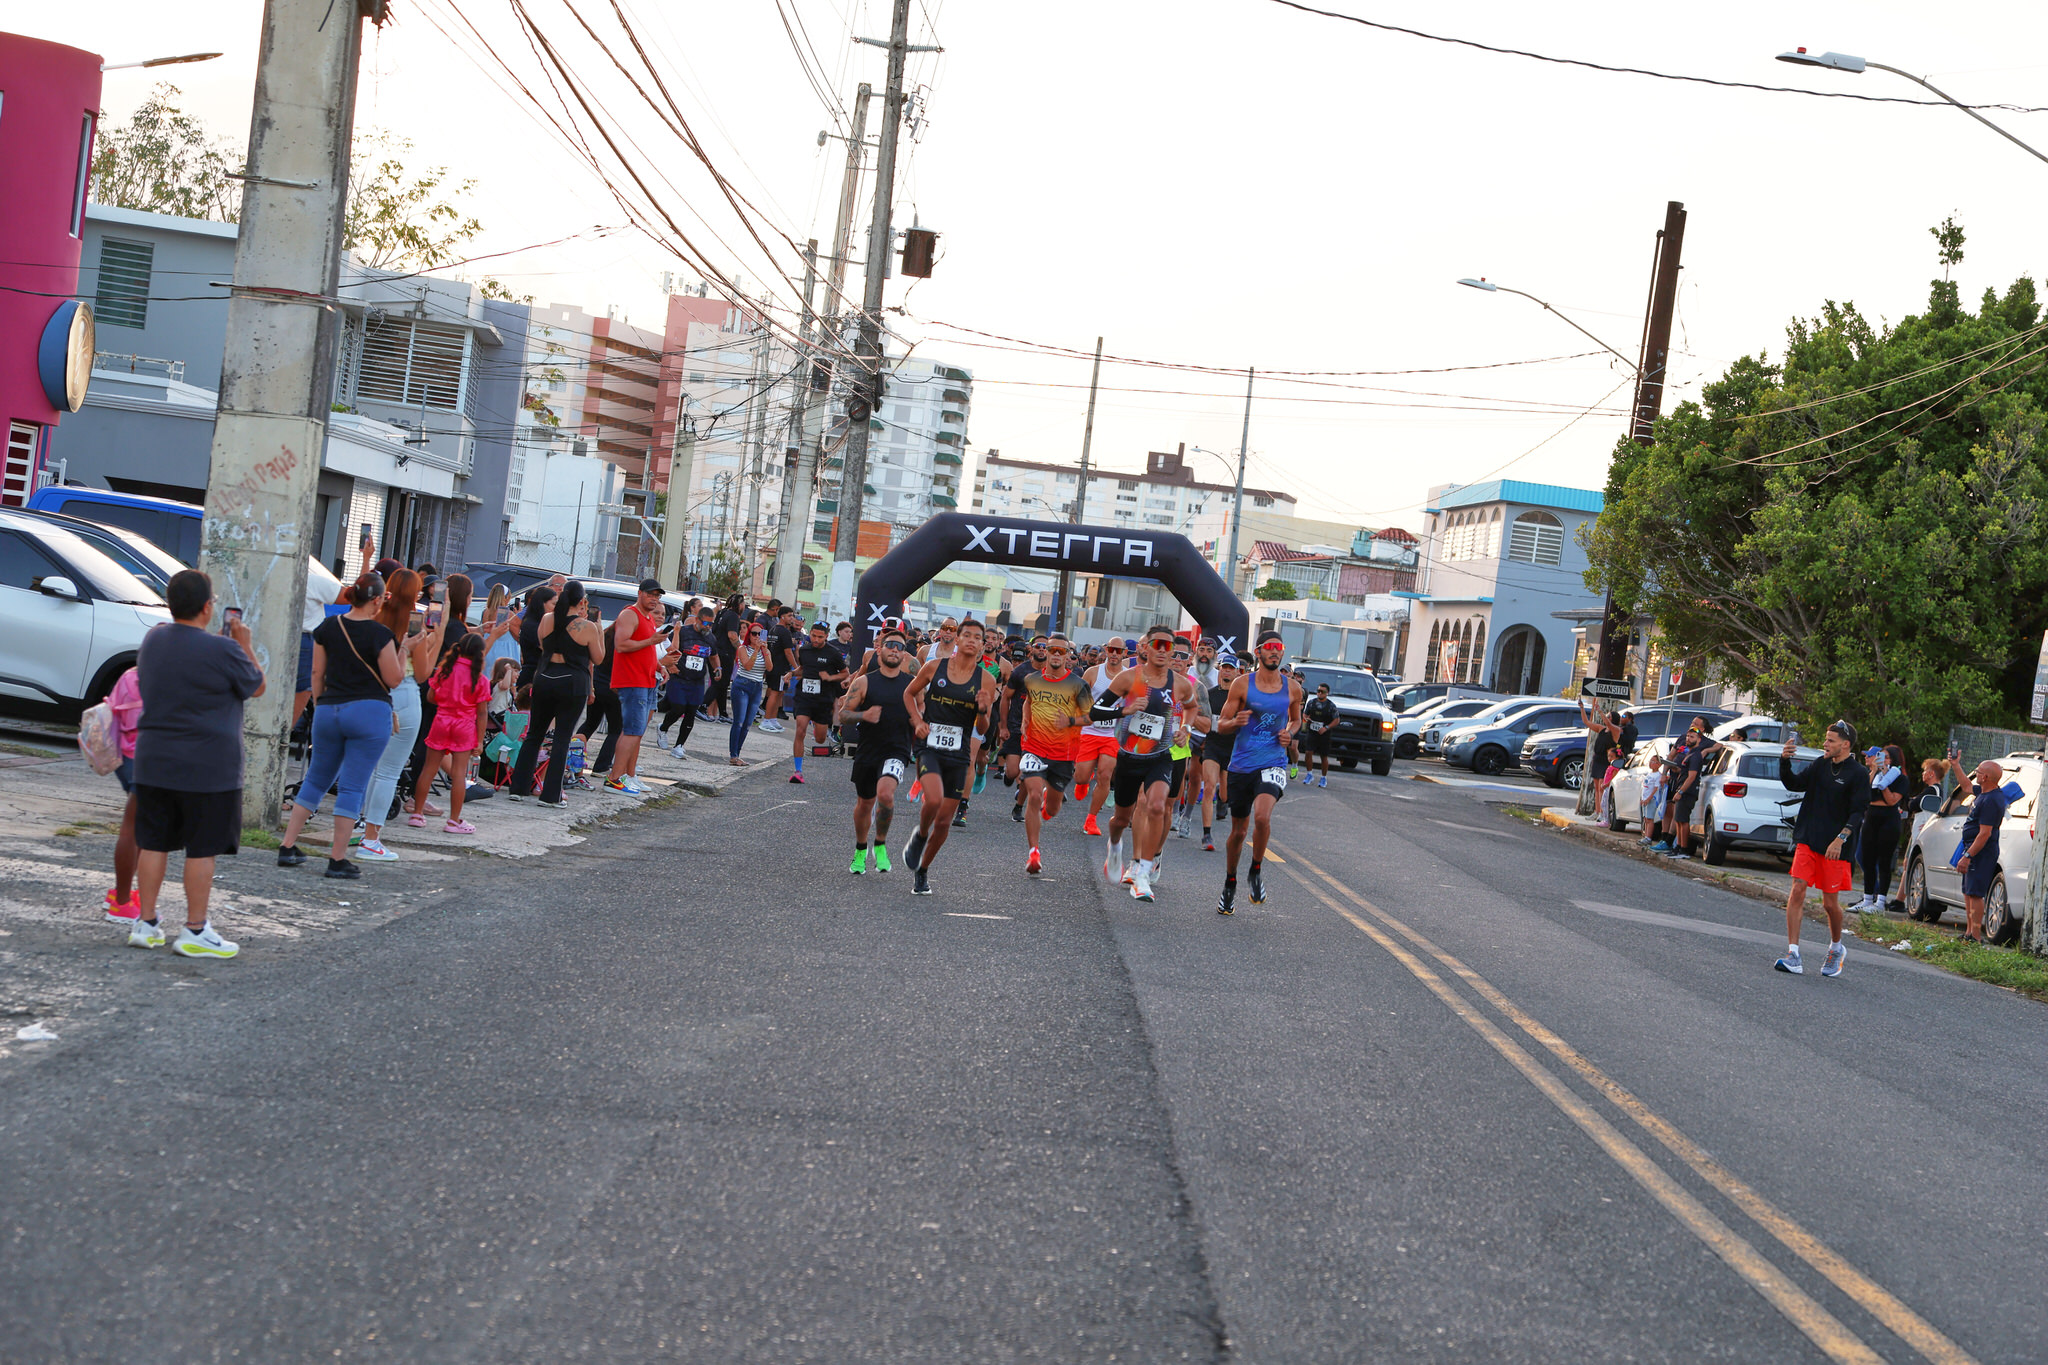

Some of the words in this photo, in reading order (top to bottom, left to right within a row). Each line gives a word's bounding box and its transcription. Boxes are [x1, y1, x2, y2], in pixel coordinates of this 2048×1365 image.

[962, 525, 1154, 567] XTERRA
[1596, 683, 1627, 694] TRANSITO
[1138, 723, 1152, 735] 95
[935, 735, 954, 747] 158
[1269, 773, 1285, 787] 109
